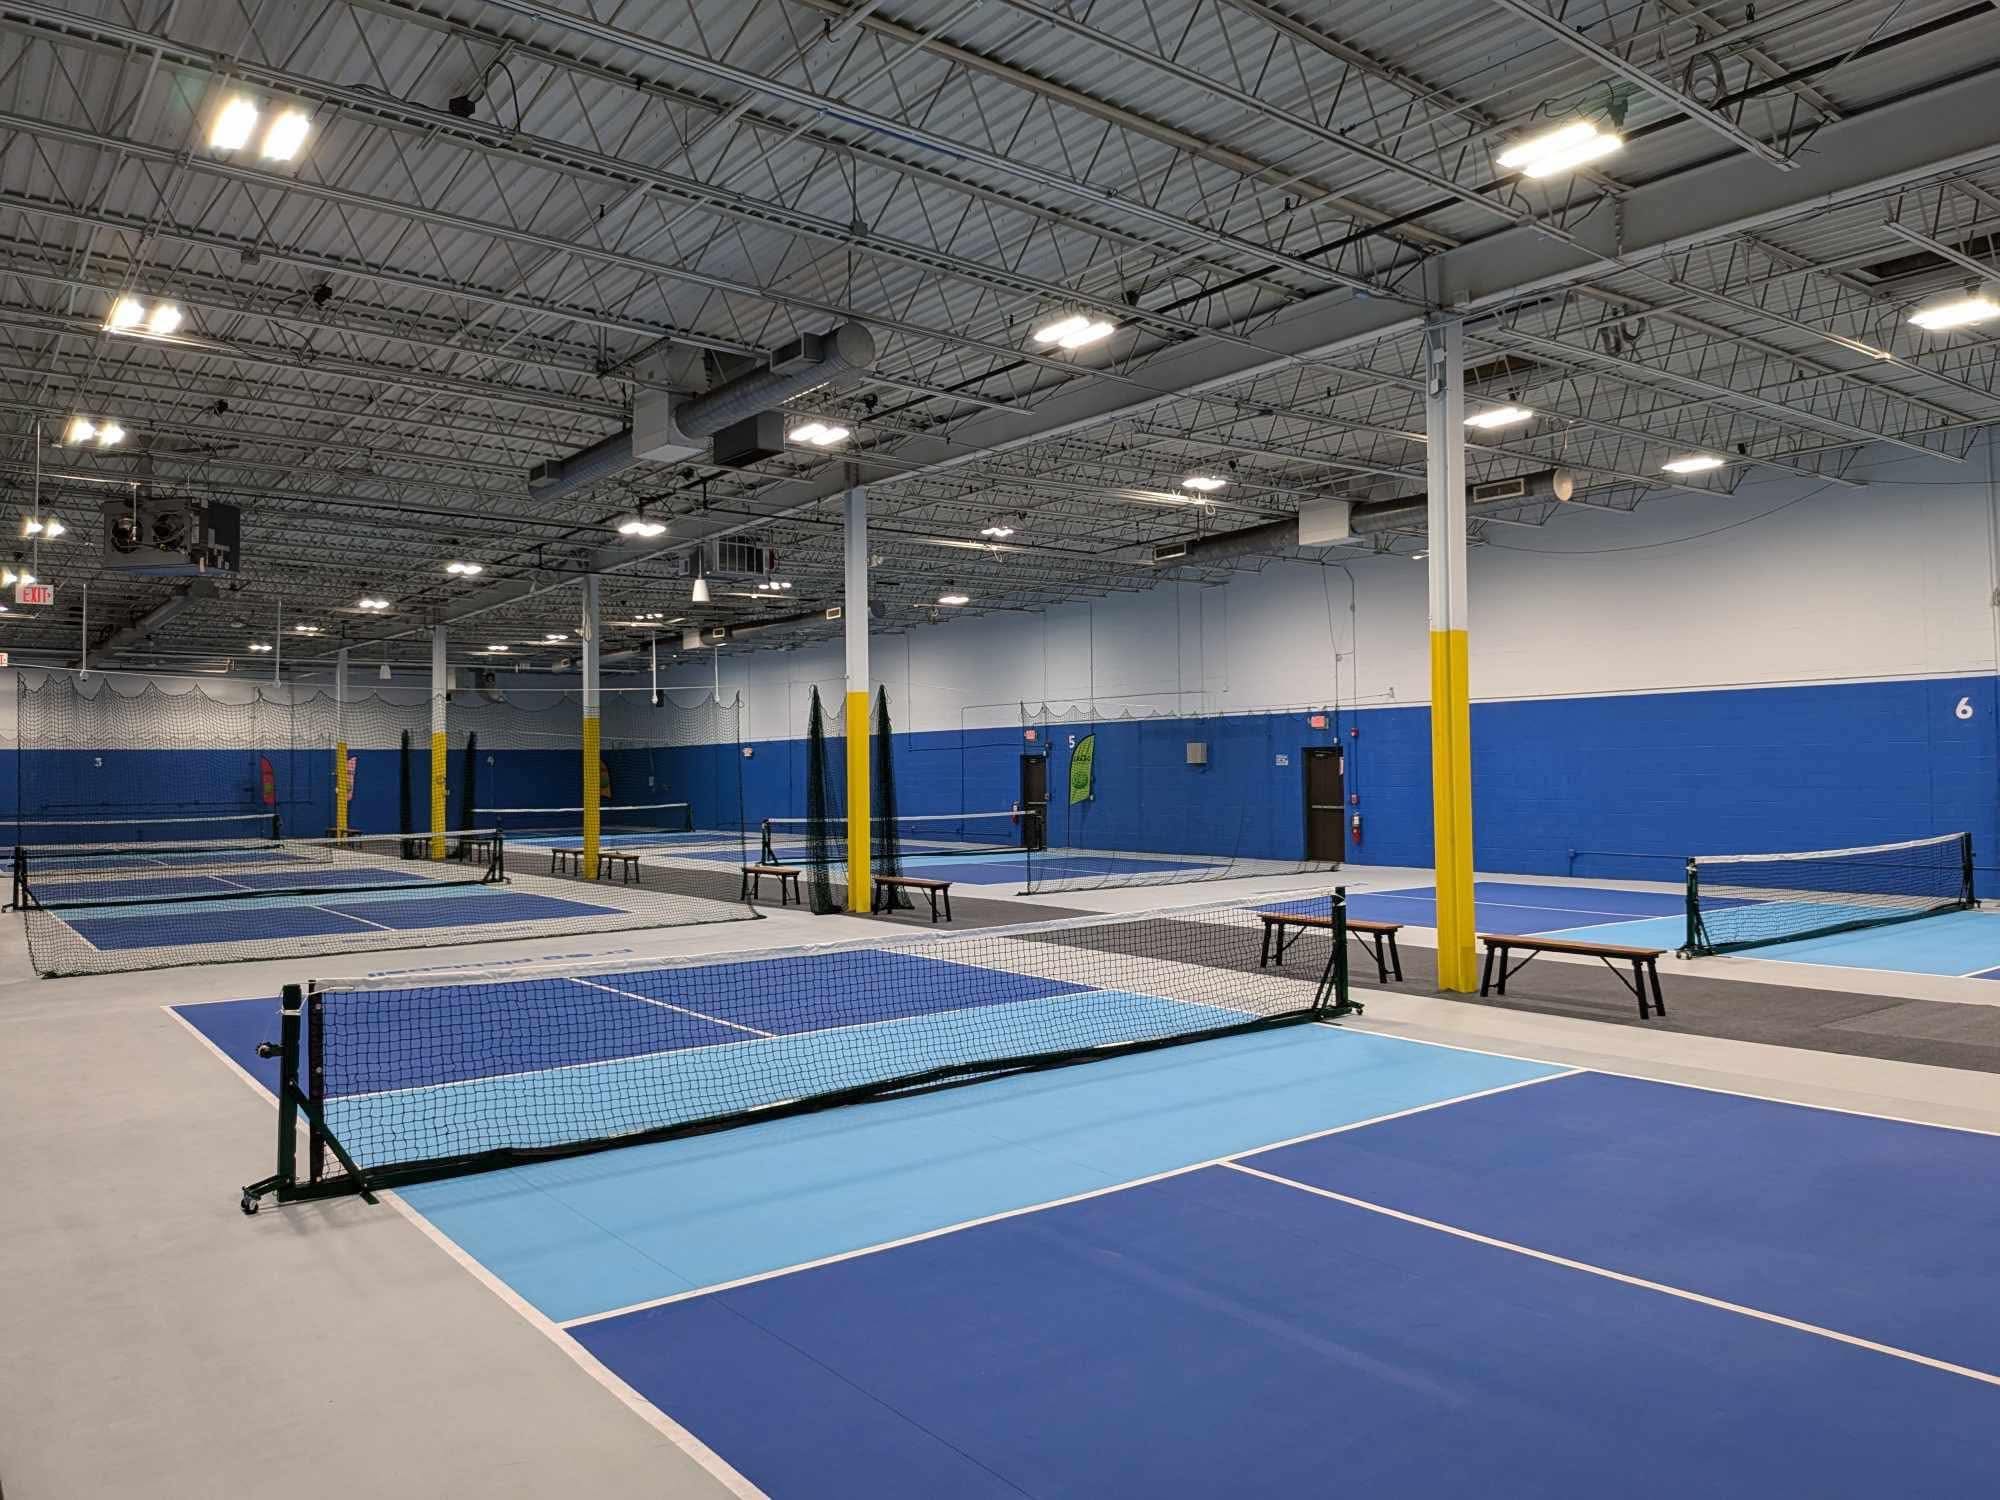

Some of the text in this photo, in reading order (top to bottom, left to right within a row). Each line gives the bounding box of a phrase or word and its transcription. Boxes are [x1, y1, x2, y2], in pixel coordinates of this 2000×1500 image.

[23, 586, 48, 602] EXIT
[1956, 697, 1973, 719] 6
[1068, 735, 1075, 748] 5
